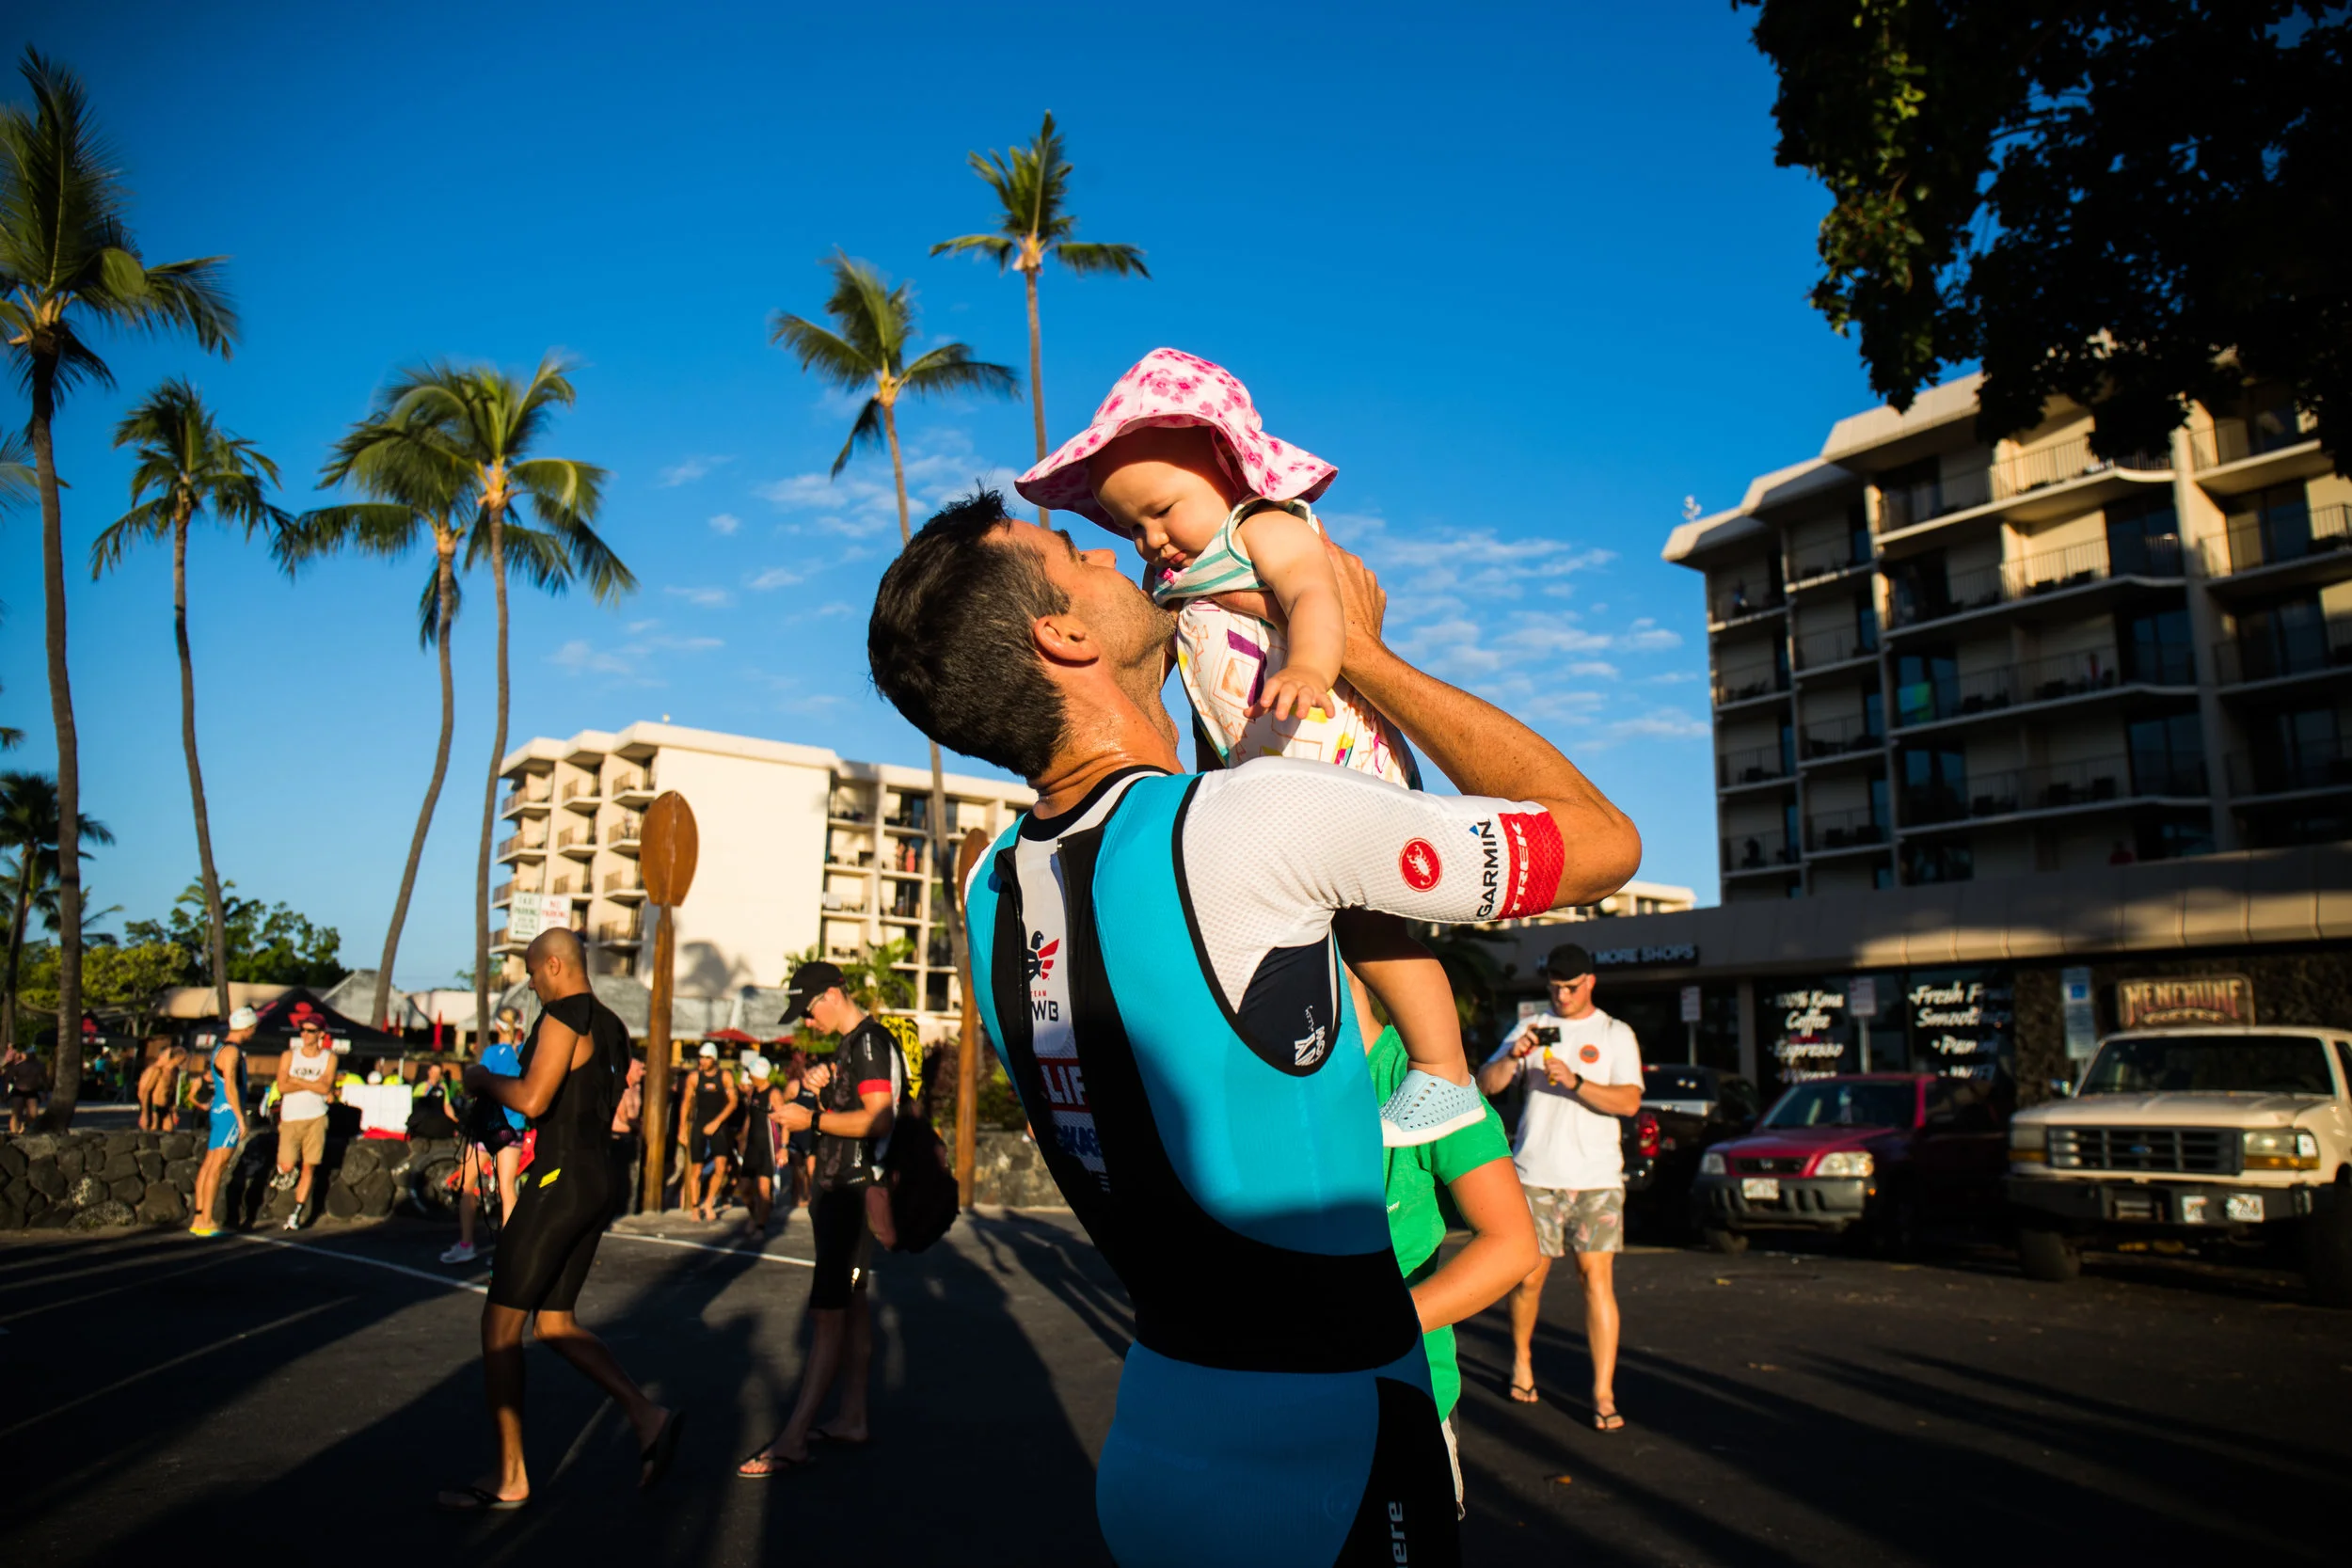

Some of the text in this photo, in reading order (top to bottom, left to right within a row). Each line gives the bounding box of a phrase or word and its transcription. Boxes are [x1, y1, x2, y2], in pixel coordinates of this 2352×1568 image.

[1476, 818, 1499, 917] GARMIN
[1507, 819, 1530, 916] TREK
[1641, 944, 1694, 962] SHOPS
[1915, 980, 1964, 1005] Fresh
[1031, 1000, 1059, 1022] WB
[1786, 1007, 1832, 1037] Coffee
[1040, 1064, 1088, 1106] LIF
[1388, 1500, 1408, 1568] ere
